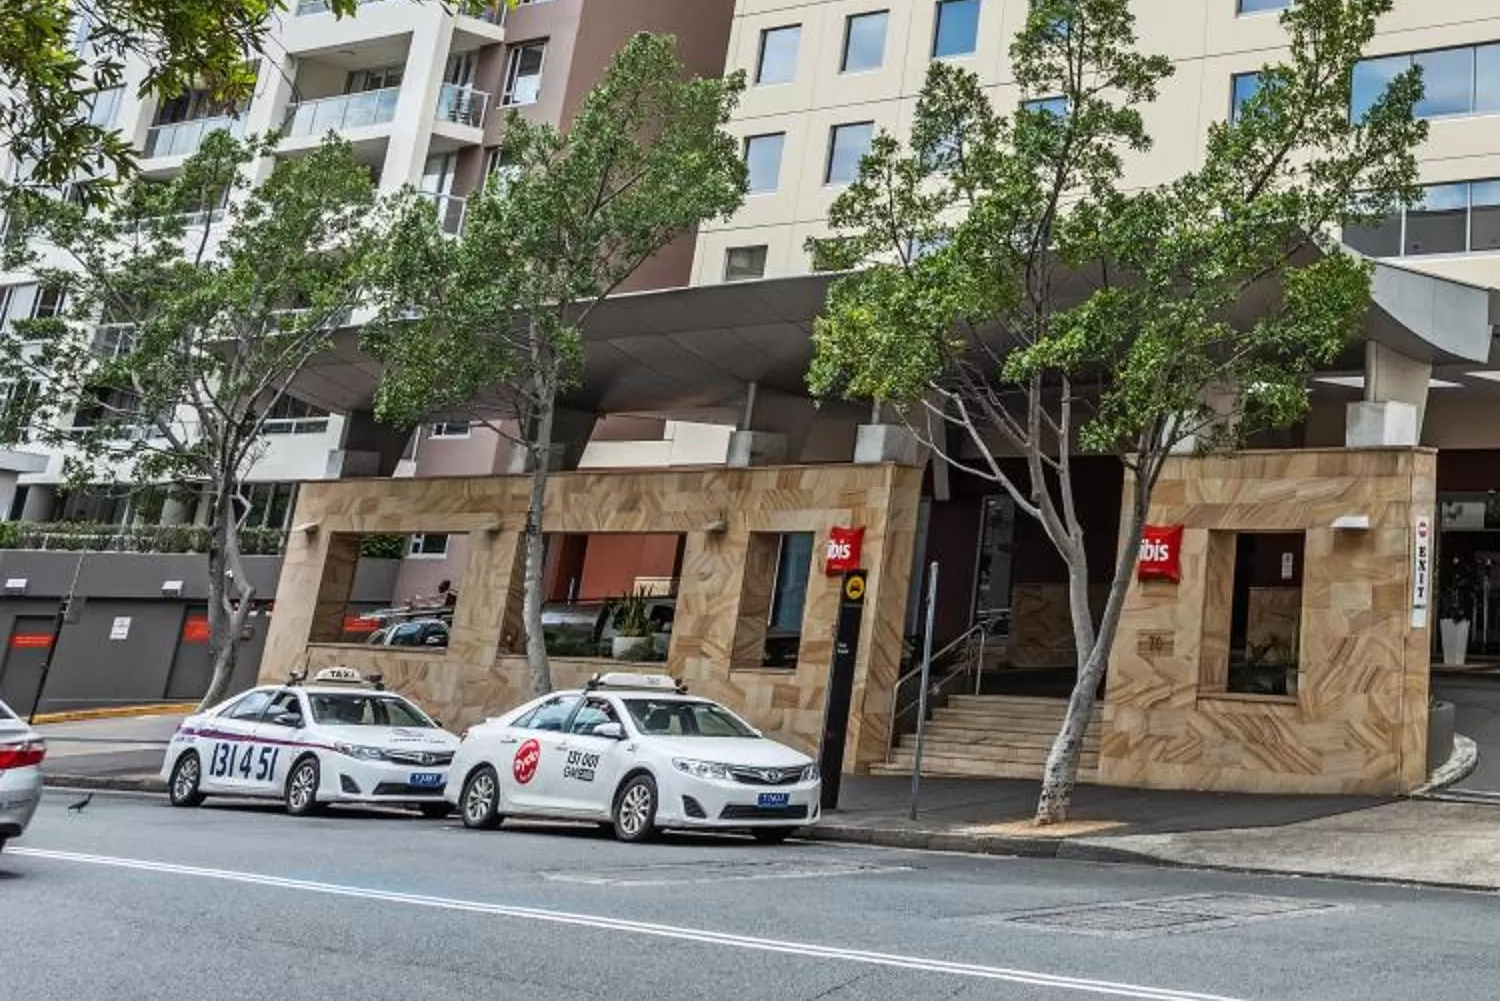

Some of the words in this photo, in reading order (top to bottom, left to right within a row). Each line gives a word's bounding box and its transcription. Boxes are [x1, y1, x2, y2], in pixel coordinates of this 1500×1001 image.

[827, 540, 851, 559] ibis
[1140, 538, 1169, 561] ibis
[1417, 546, 1427, 598] EXIT
[330, 670, 355, 678] TAXI
